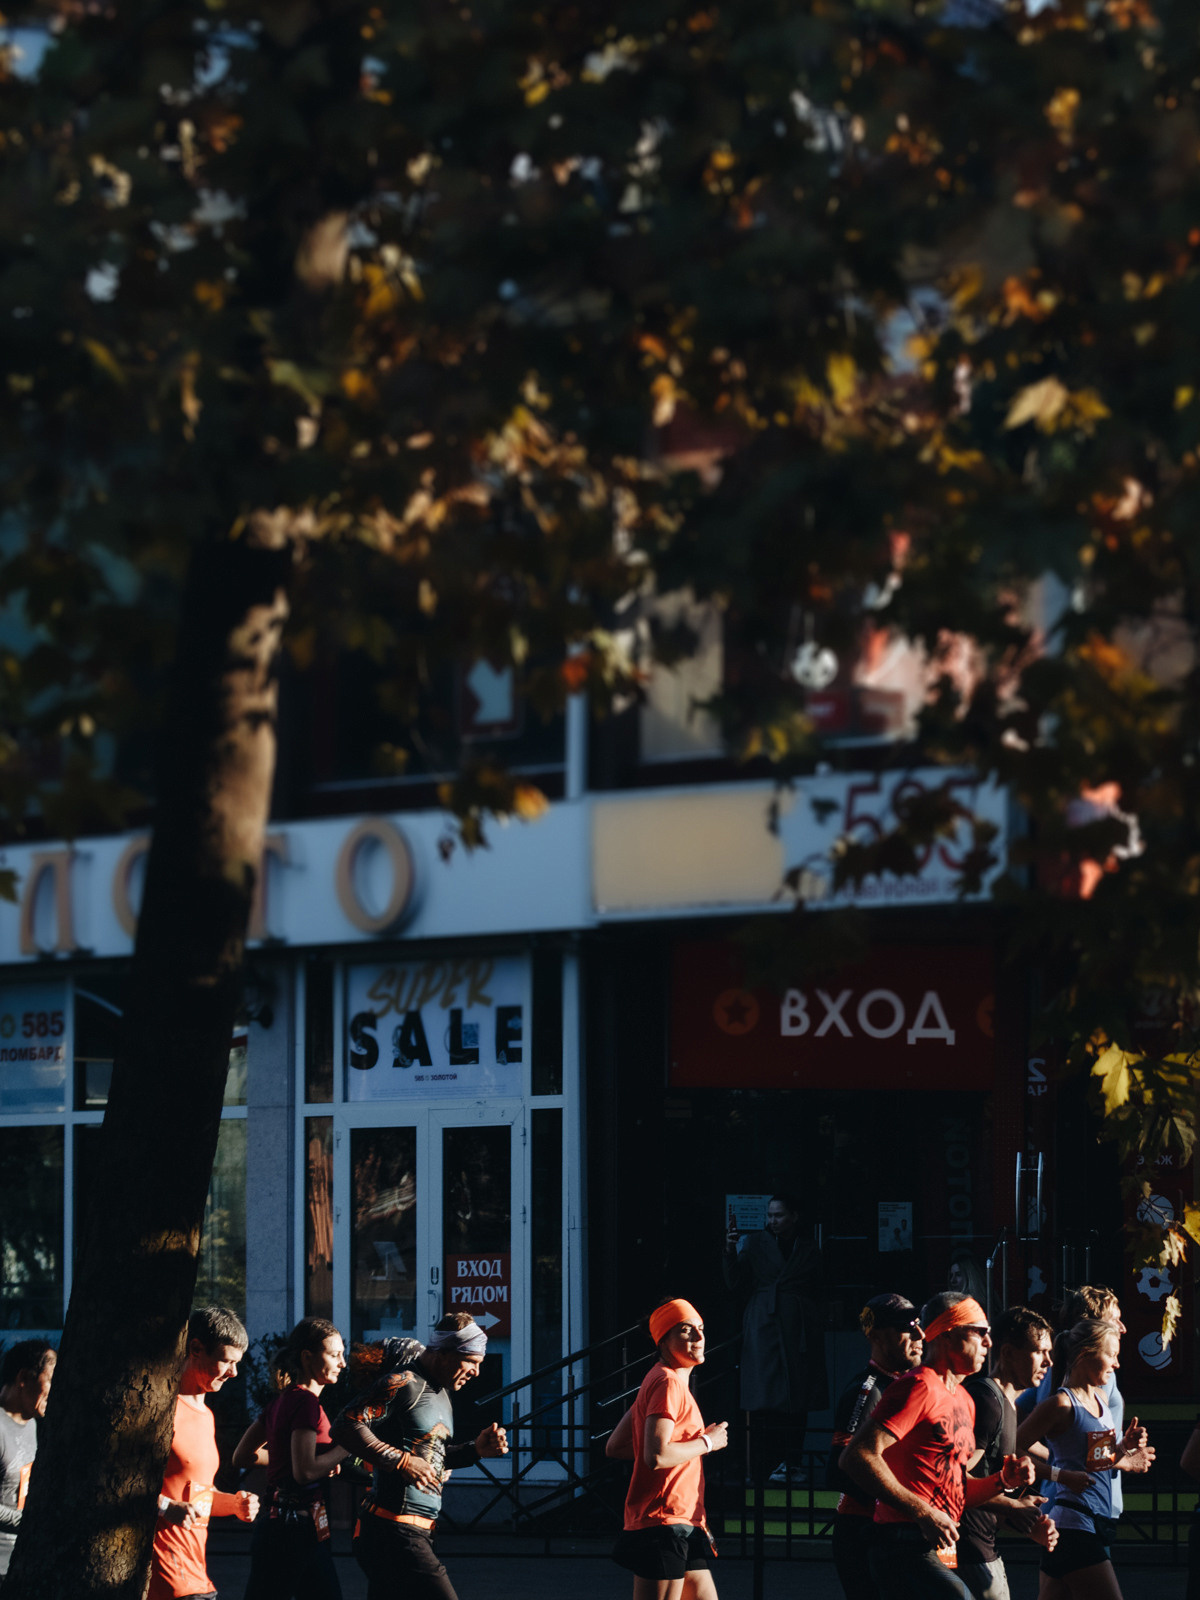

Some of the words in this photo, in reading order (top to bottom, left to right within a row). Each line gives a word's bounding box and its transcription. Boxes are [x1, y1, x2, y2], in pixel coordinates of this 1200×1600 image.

[367, 958, 494, 1018] SUPER
[22, 1011, 64, 1038] 585
[780, 988, 956, 1045] ВХОД
[350, 1005, 522, 1070] SALE
[1136, 1154, 1173, 1166] ЭЖ
[456, 1259, 503, 1280] ВХОД
[451, 1285, 508, 1306] РЯДОМ
